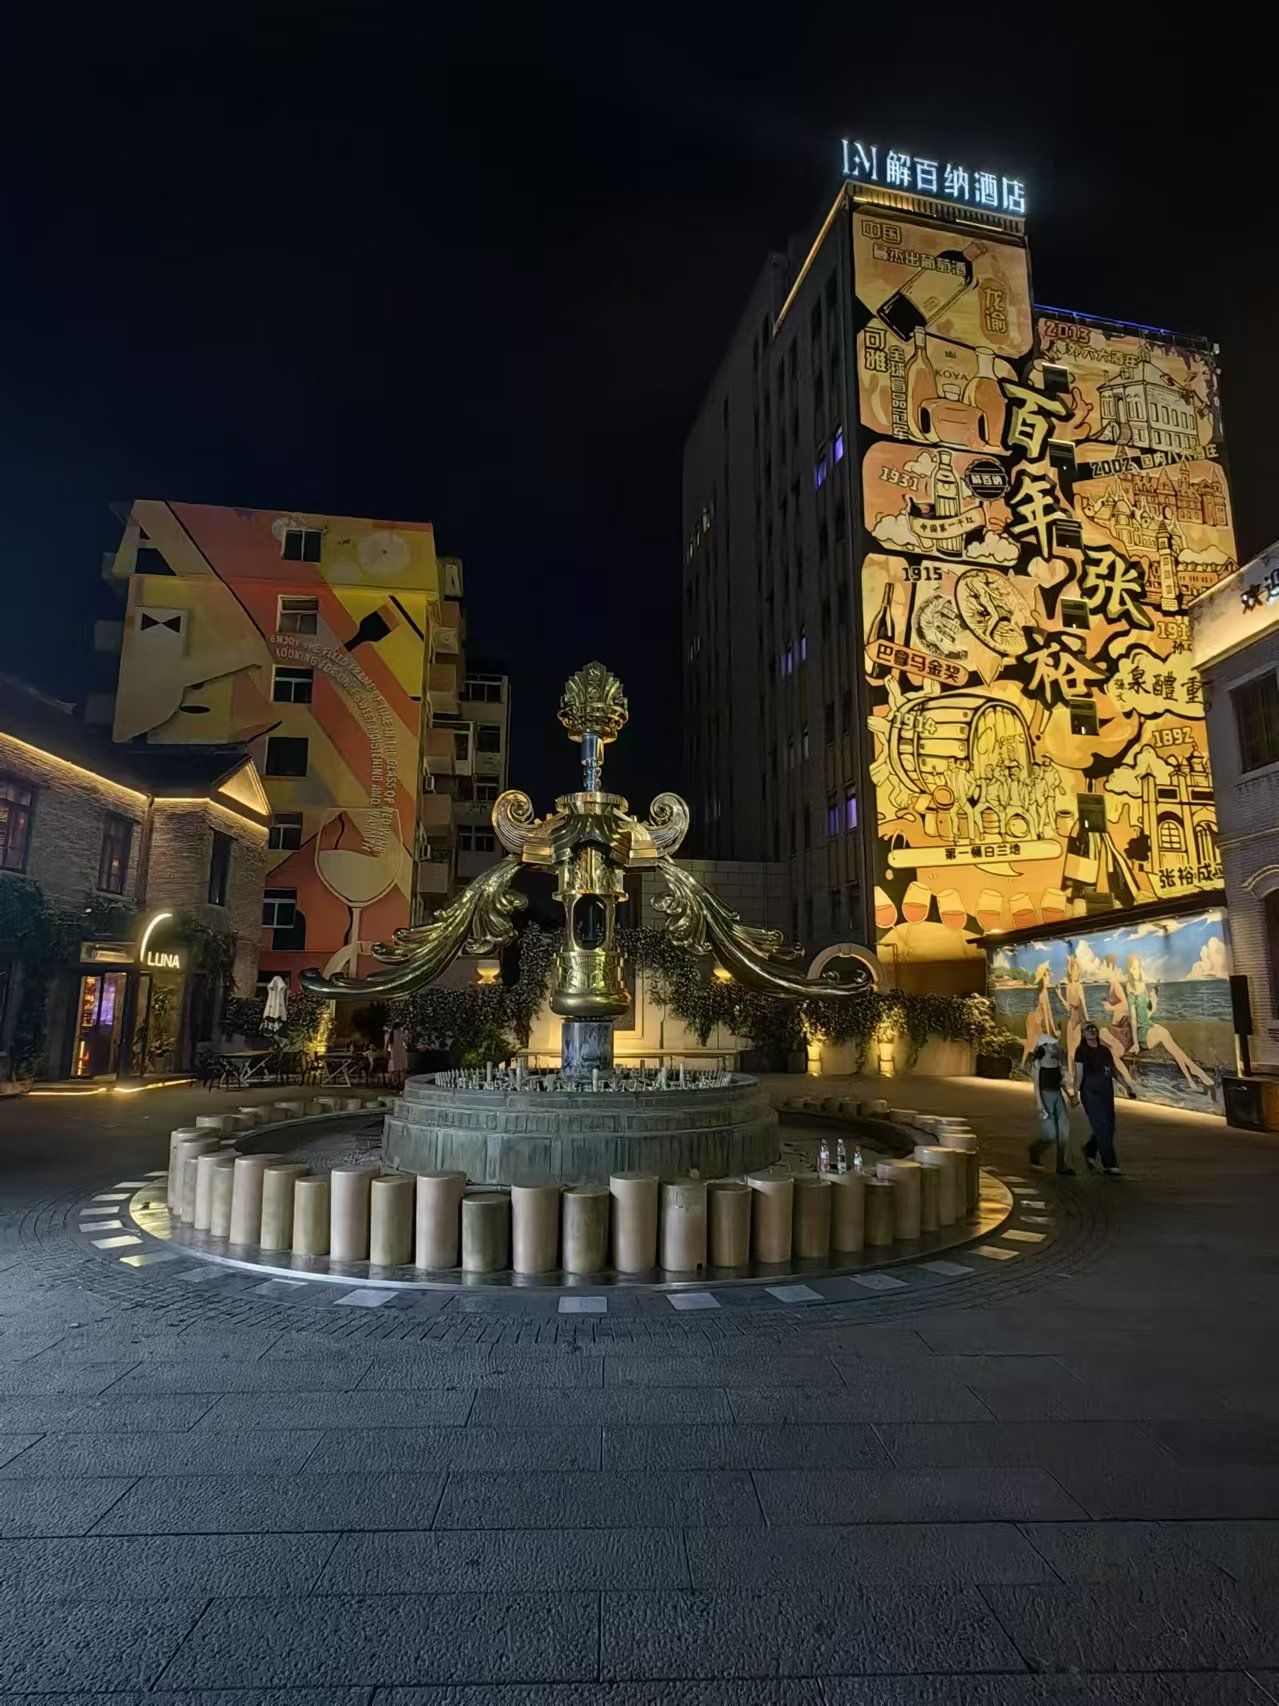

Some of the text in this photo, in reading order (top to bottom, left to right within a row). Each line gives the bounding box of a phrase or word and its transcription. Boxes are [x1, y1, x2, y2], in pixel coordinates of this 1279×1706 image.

[886, 149, 1026, 213] 解百纳酒店
[862, 220, 901, 245] 中国
[1044, 320, 1091, 344] 2013
[864, 327, 889, 372] 可雅
[935, 368, 969, 382] KOYA
[1091, 458, 1133, 477] 2002
[880, 466, 919, 492] 1931
[919, 516, 976, 533] 中国第一干红
[902, 566, 943, 582] 1915
[893, 711, 938, 735] 1914
[1152, 726, 1195, 748] 1892
[370, 784, 381, 806] AND
[944, 844, 1021, 861] 第一桶白兰地
[147, 951, 180, 969] LUNA
